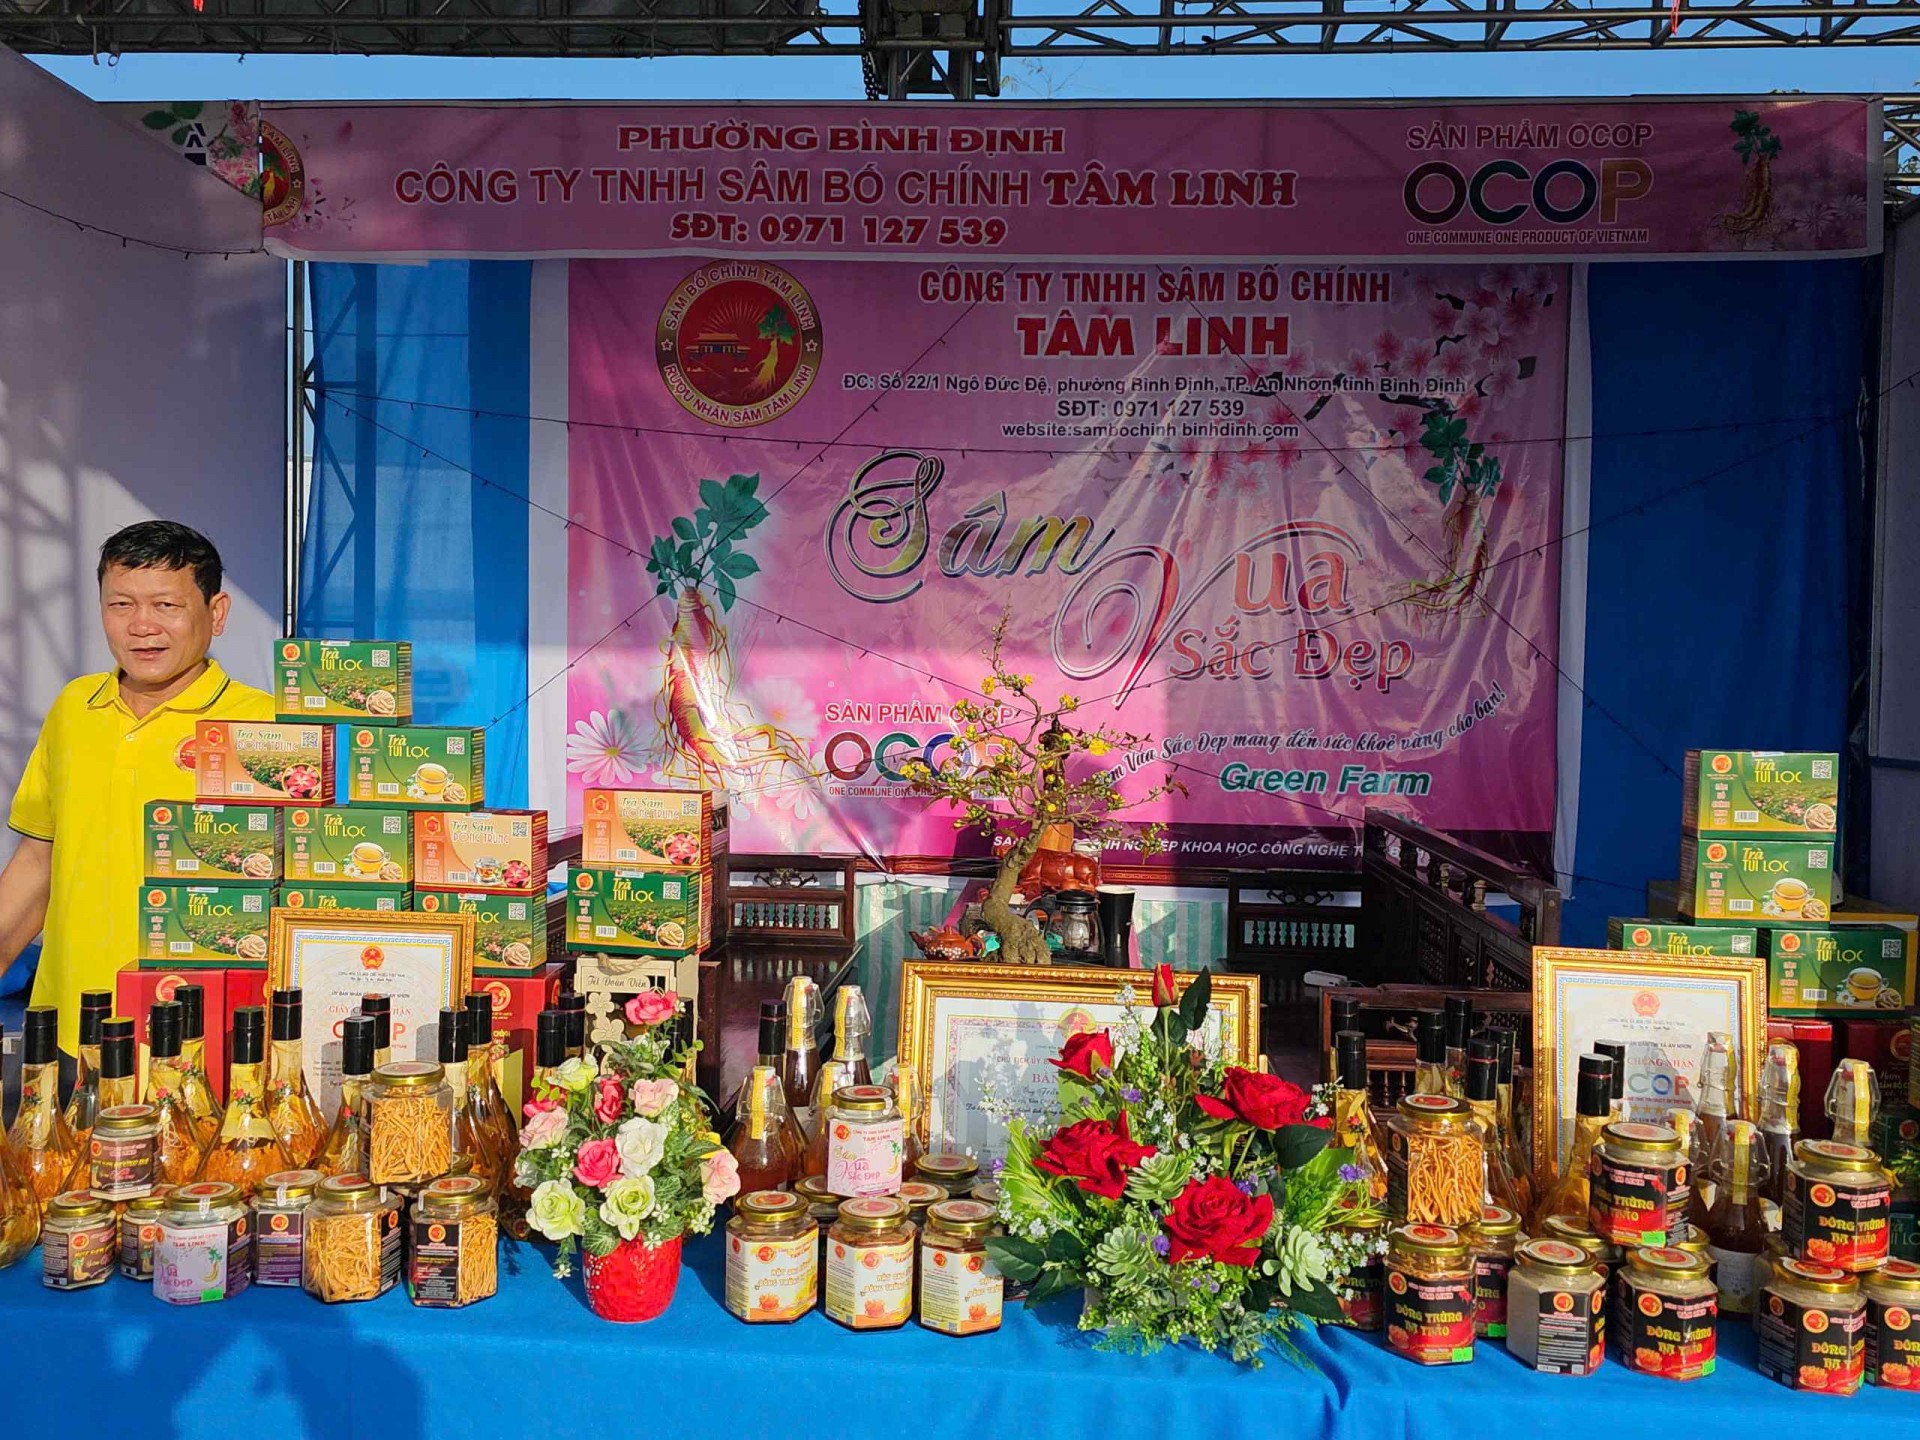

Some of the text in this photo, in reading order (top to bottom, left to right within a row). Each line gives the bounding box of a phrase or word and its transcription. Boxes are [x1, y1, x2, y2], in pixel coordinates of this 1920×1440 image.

[618, 117, 1064, 158] PHƯỜNG BÌNH ĐỊNH
[1406, 119, 1654, 149] SẢN PHẨM OCOP
[395, 161, 1297, 207] CÔNG TY TNHH SÂM BỐ CHÍNH TÂM LINH
[1402, 158, 1655, 225] OCOP
[669, 213, 1008, 246] SĐT: 0971 127 539
[1406, 230, 1649, 244] ONE COMMUNE ONE PRODUCT OF VIETNAM
[665, 296, 688, 330] SÂM
[709, 260, 760, 282] CHÍNH
[762, 268, 793, 296] TÂM
[789, 292, 816, 331] LINH
[918, 262, 1392, 304] CÔNG TY TNHH SÂM BỐ CHÍNH
[1016, 309, 1290, 357] TÂM LINH
[788, 363, 814, 396] LINH
[842, 375, 876, 390] ĐC:
[879, 370, 904, 391] Số
[905, 374, 941, 391] 22/1
[946, 374, 981, 394] Ngô
[984, 373, 1021, 392] Đức
[1057, 371, 1127, 396] phường
[1130, 374, 1171, 394] Bình
[1256, 376, 1281, 393] An
[1380, 375, 1421, 395] Bình
[1425, 377, 1467, 396] Định
[1056, 399, 1245, 418] SĐT: 0971 127 539
[824, 447, 1117, 604] Sâm
[1169, 614, 1416, 692] Sắc Đẹp
[825, 699, 942, 724] SẢN PHẨM
[1160, 732, 1194, 759] Sắc
[1196, 731, 1229, 755] Đẹp
[1232, 733, 1281, 754] mang
[1284, 728, 1320, 750] đến
[1400, 729, 1445, 755] vàng
[1447, 712, 1475, 739] cho
[1219, 761, 1433, 796] Green Farm
[1181, 840, 1348, 860] KHOA HỌC CÔNG NGHỆ
